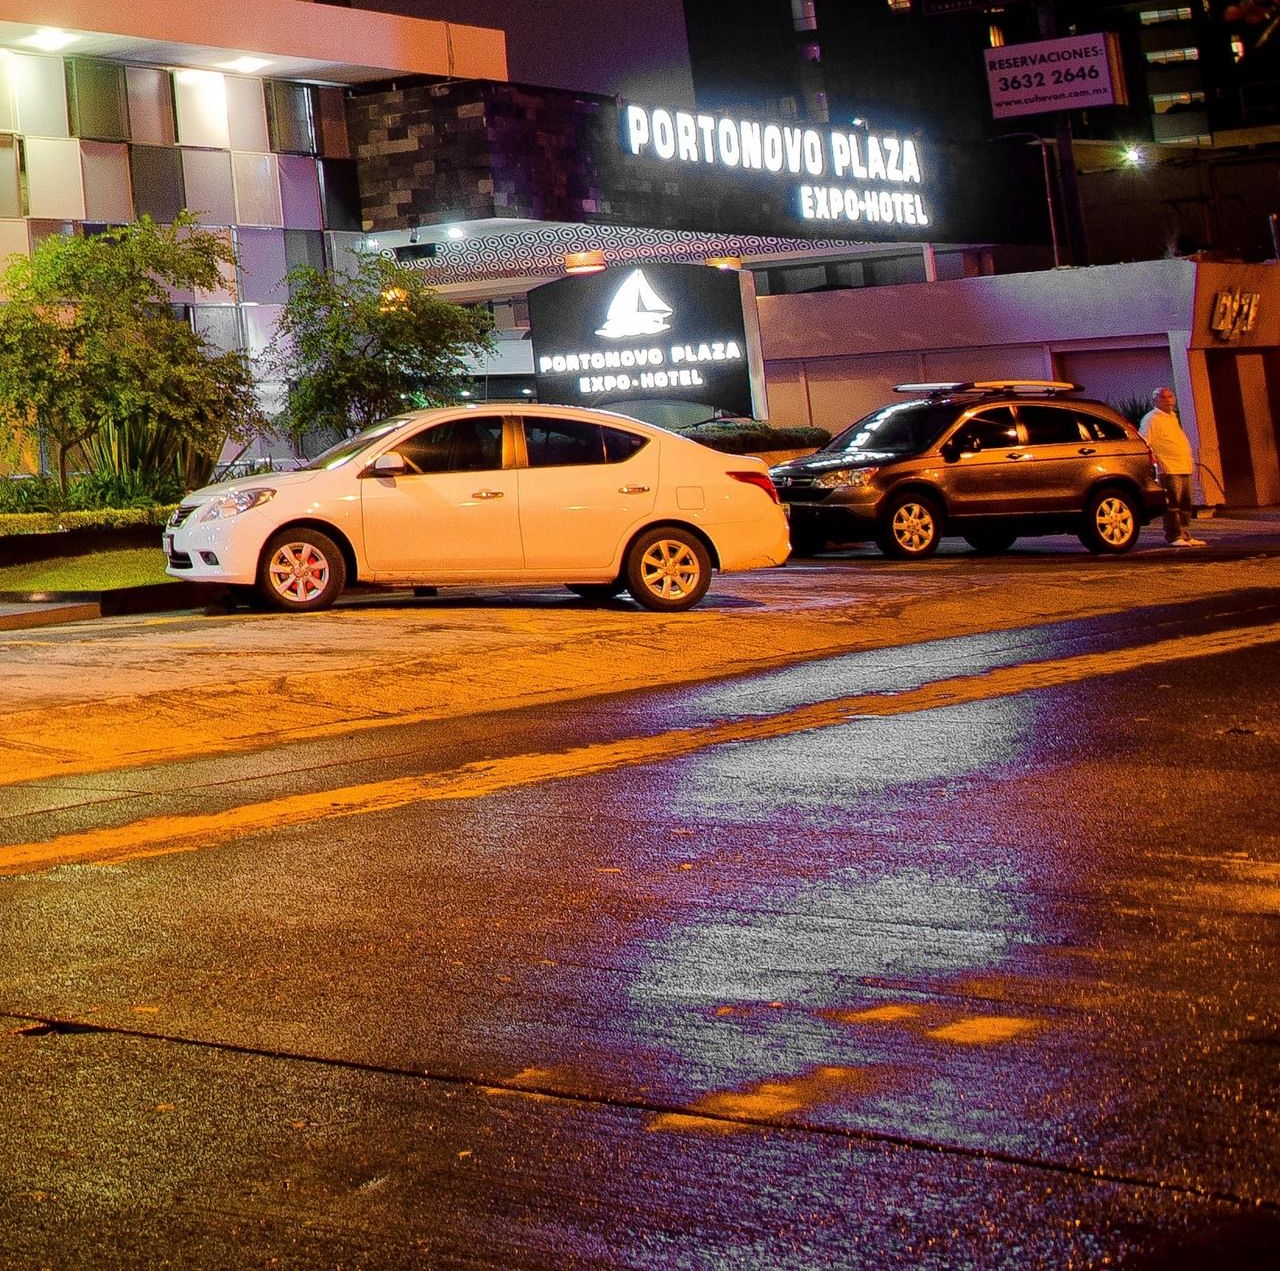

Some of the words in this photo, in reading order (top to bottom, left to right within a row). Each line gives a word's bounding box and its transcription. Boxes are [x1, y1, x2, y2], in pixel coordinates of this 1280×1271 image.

[989, 46, 1104, 72] RESERVACIONES:
[999, 73, 1046, 92] 3632
[1052, 65, 1100, 85] 2646
[995, 87, 1108, 109] www.cuhevon.com.mx
[627, 105, 824, 176] PORTONOVO
[831, 131, 921, 184] PLAZA
[539, 348, 664, 374] PORTONOVO
[671, 341, 741, 363] PLAZA
